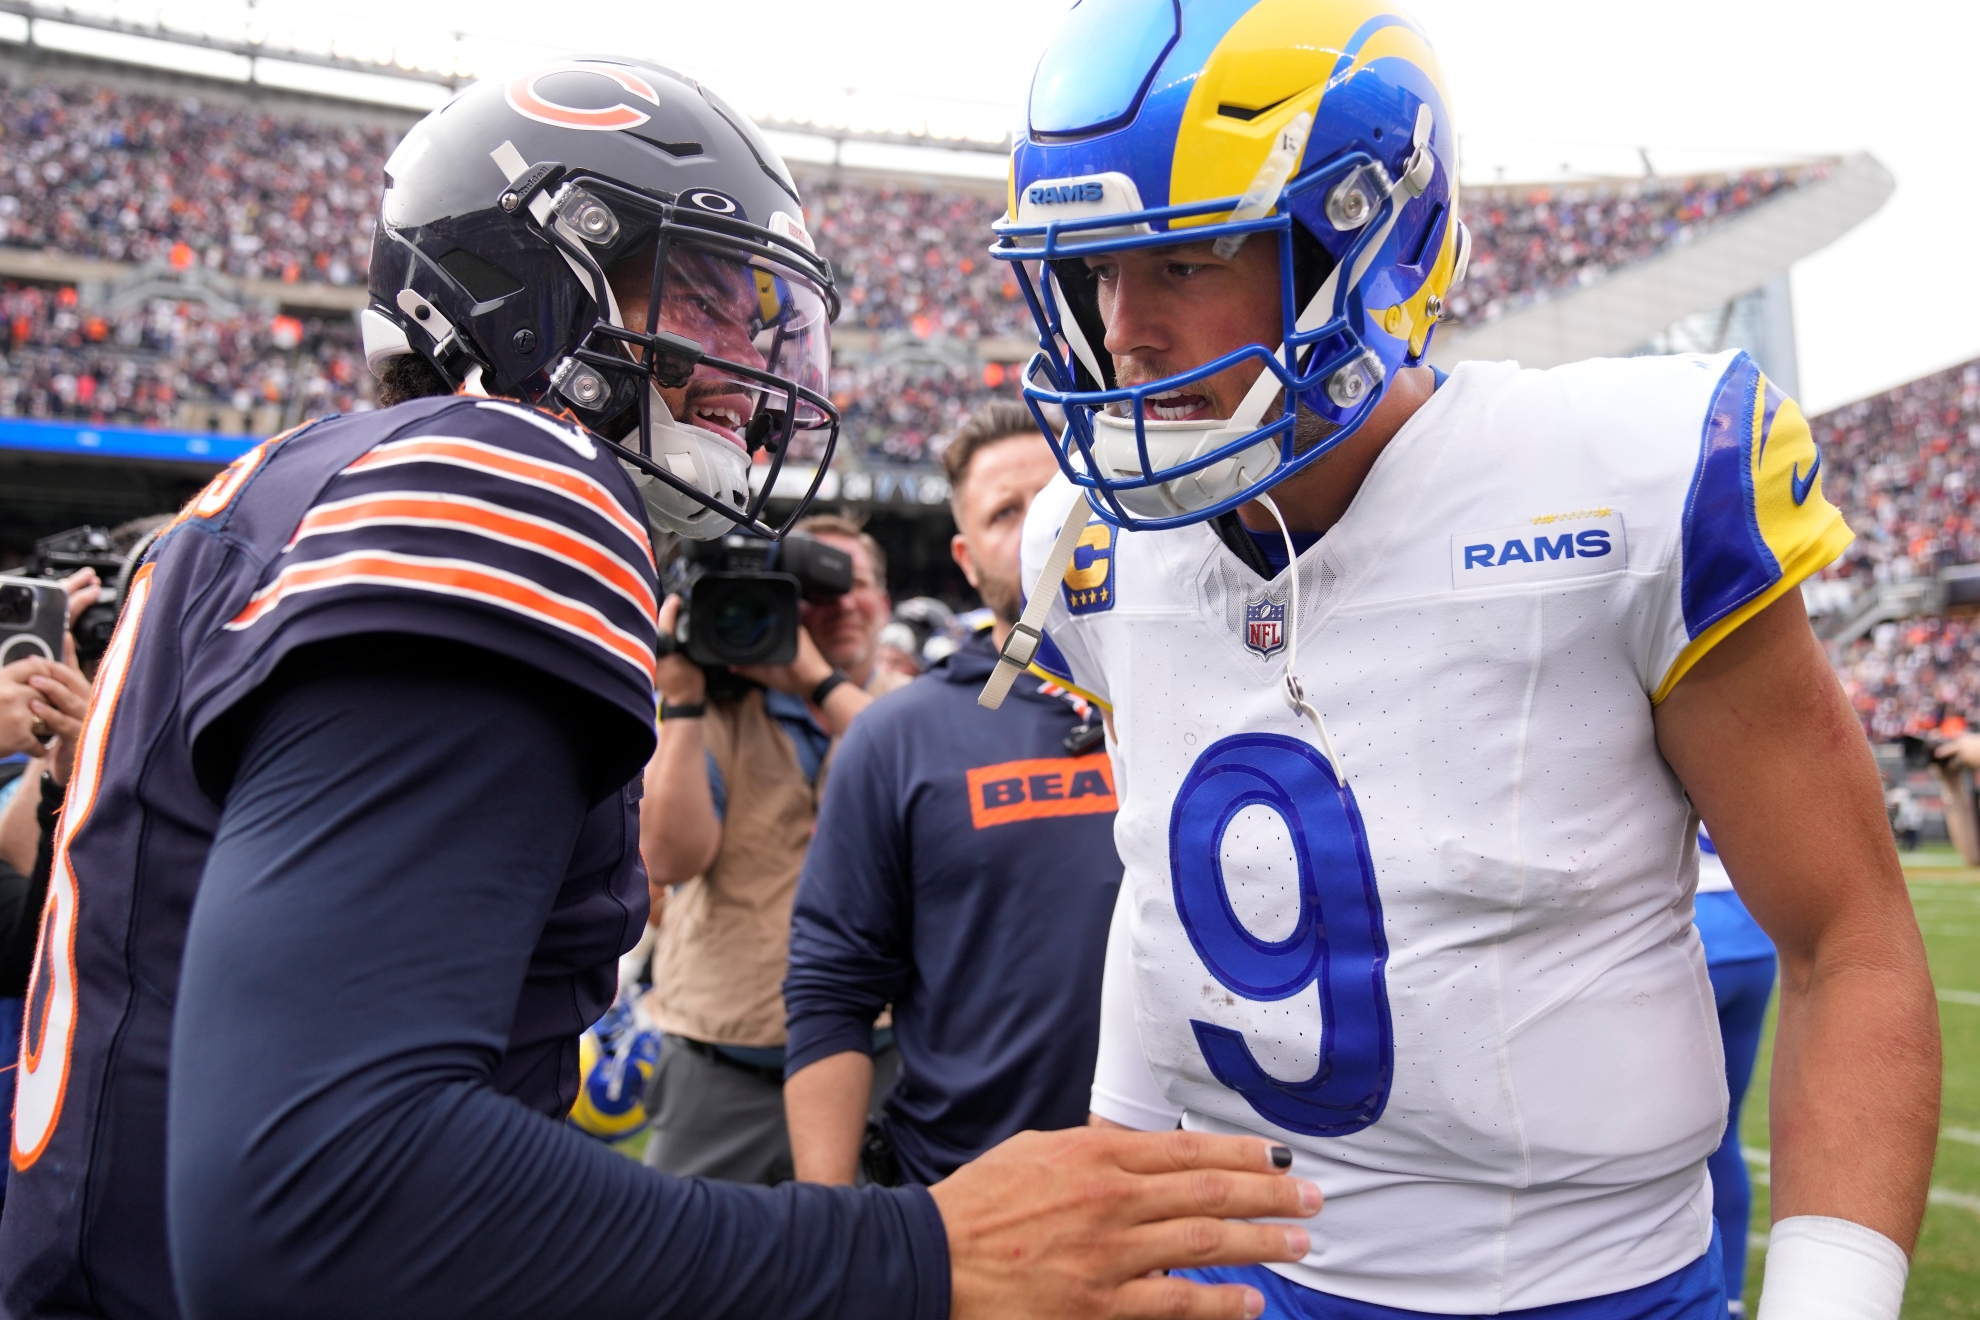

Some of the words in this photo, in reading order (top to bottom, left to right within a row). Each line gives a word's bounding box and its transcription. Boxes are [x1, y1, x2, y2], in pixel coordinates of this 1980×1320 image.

[504, 61, 660, 132] C
[1028, 182, 1104, 205] RAMS
[1064, 523, 1111, 591] C
[1464, 529, 1612, 570] RAMS
[1249, 623, 1281, 649] NFL
[1169, 732, 1394, 1137] 9
